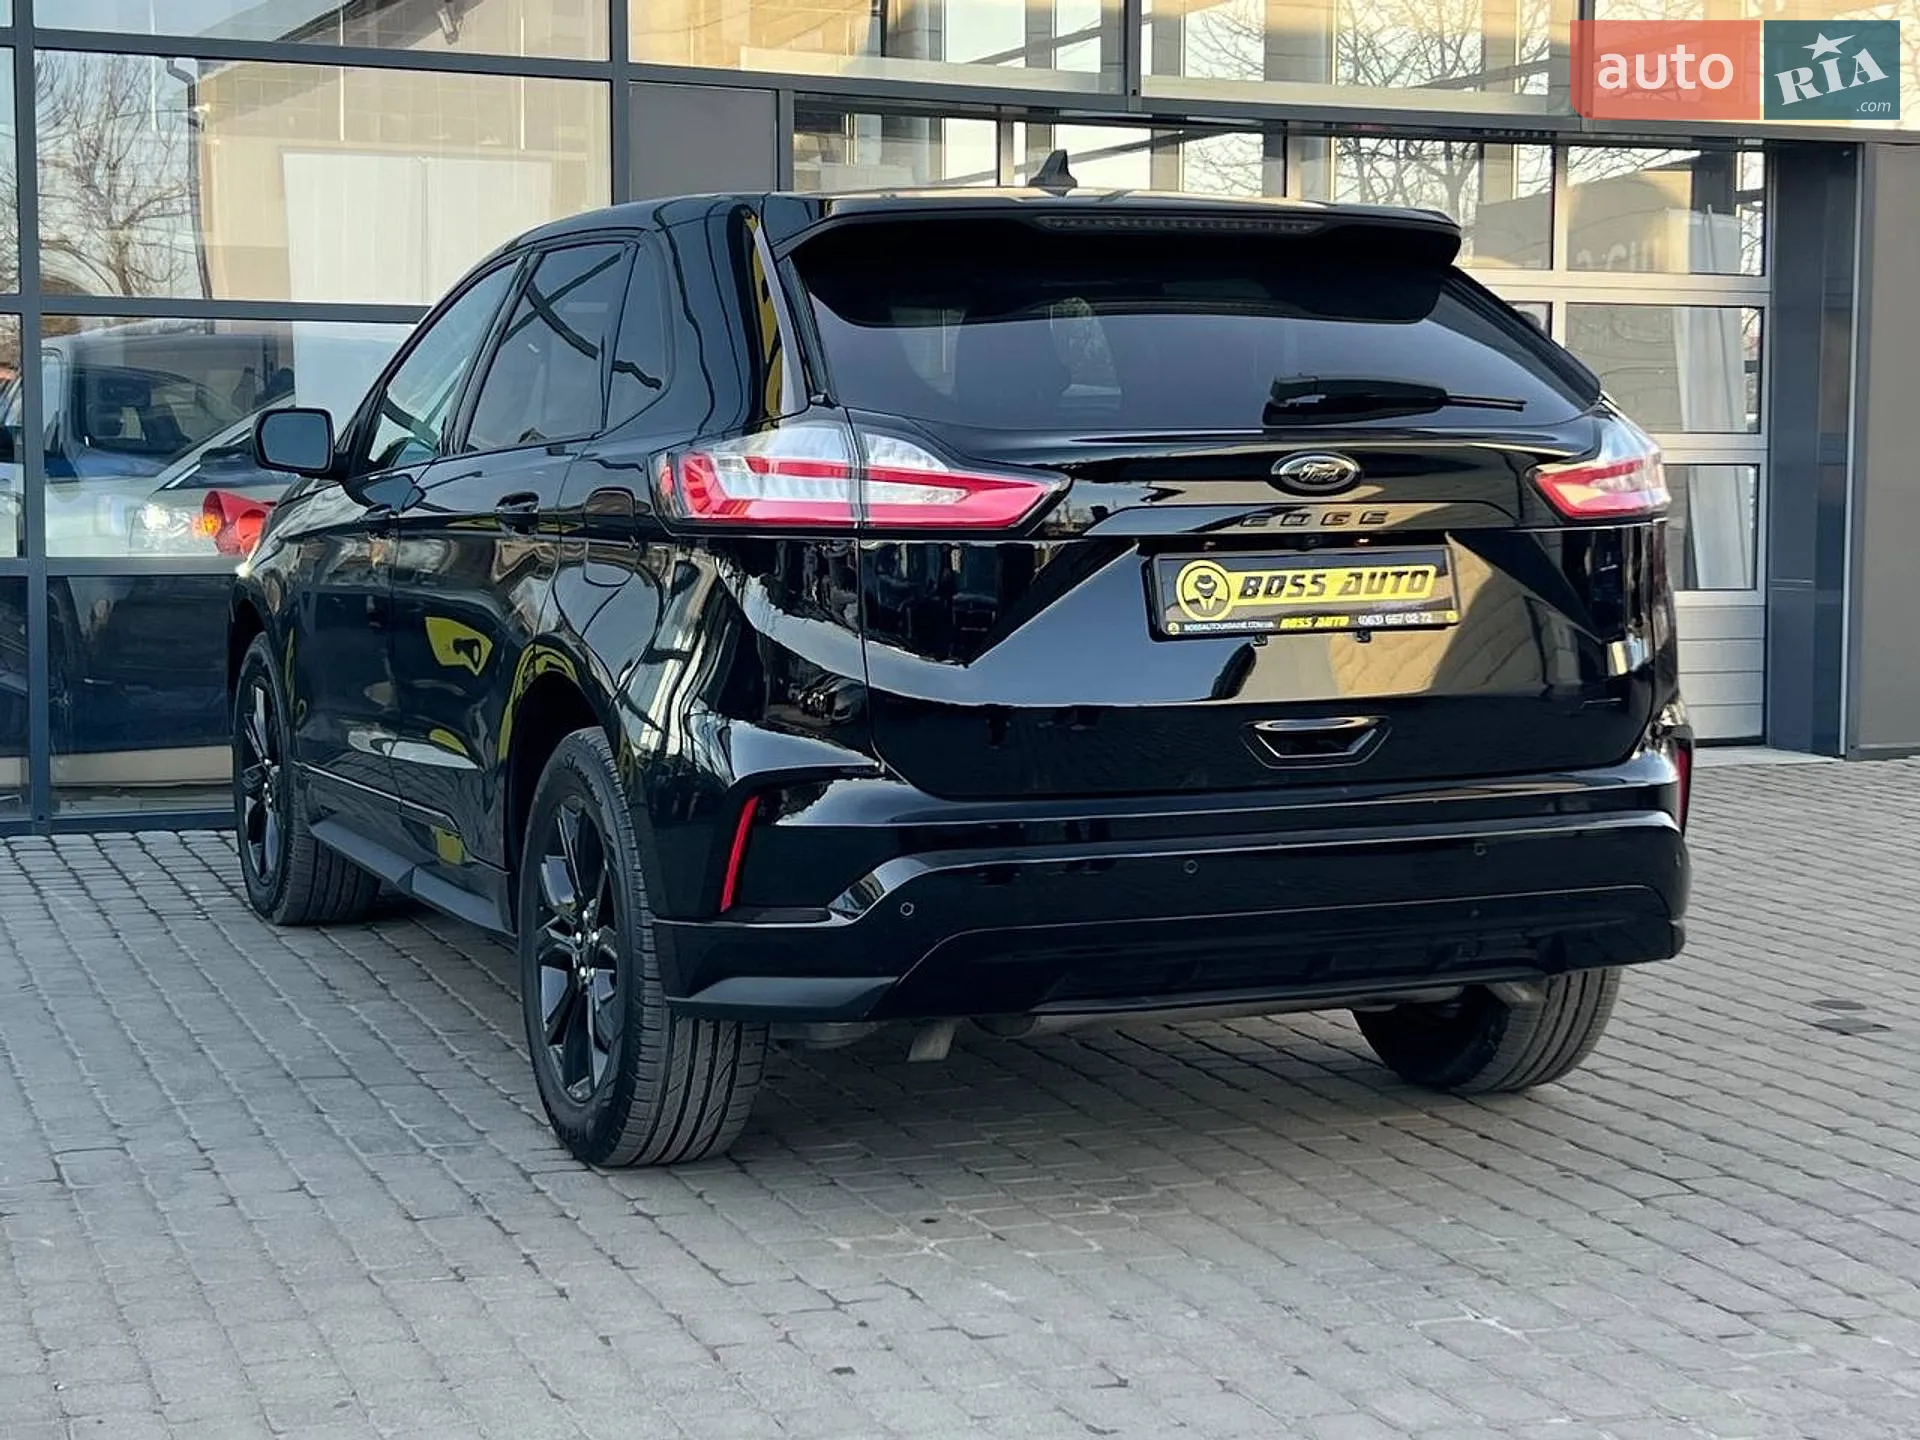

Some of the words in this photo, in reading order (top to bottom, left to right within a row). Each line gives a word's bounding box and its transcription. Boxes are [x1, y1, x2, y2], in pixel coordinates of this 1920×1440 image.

[1300, 461, 1347, 482] Ford
[1240, 510, 1388, 528] EDGE
[1238, 574, 1326, 600] BOSS
[1337, 570, 1429, 596] AUTO
[1280, 617, 1314, 630] BOSS
[1313, 615, 1349, 628] AUTO
